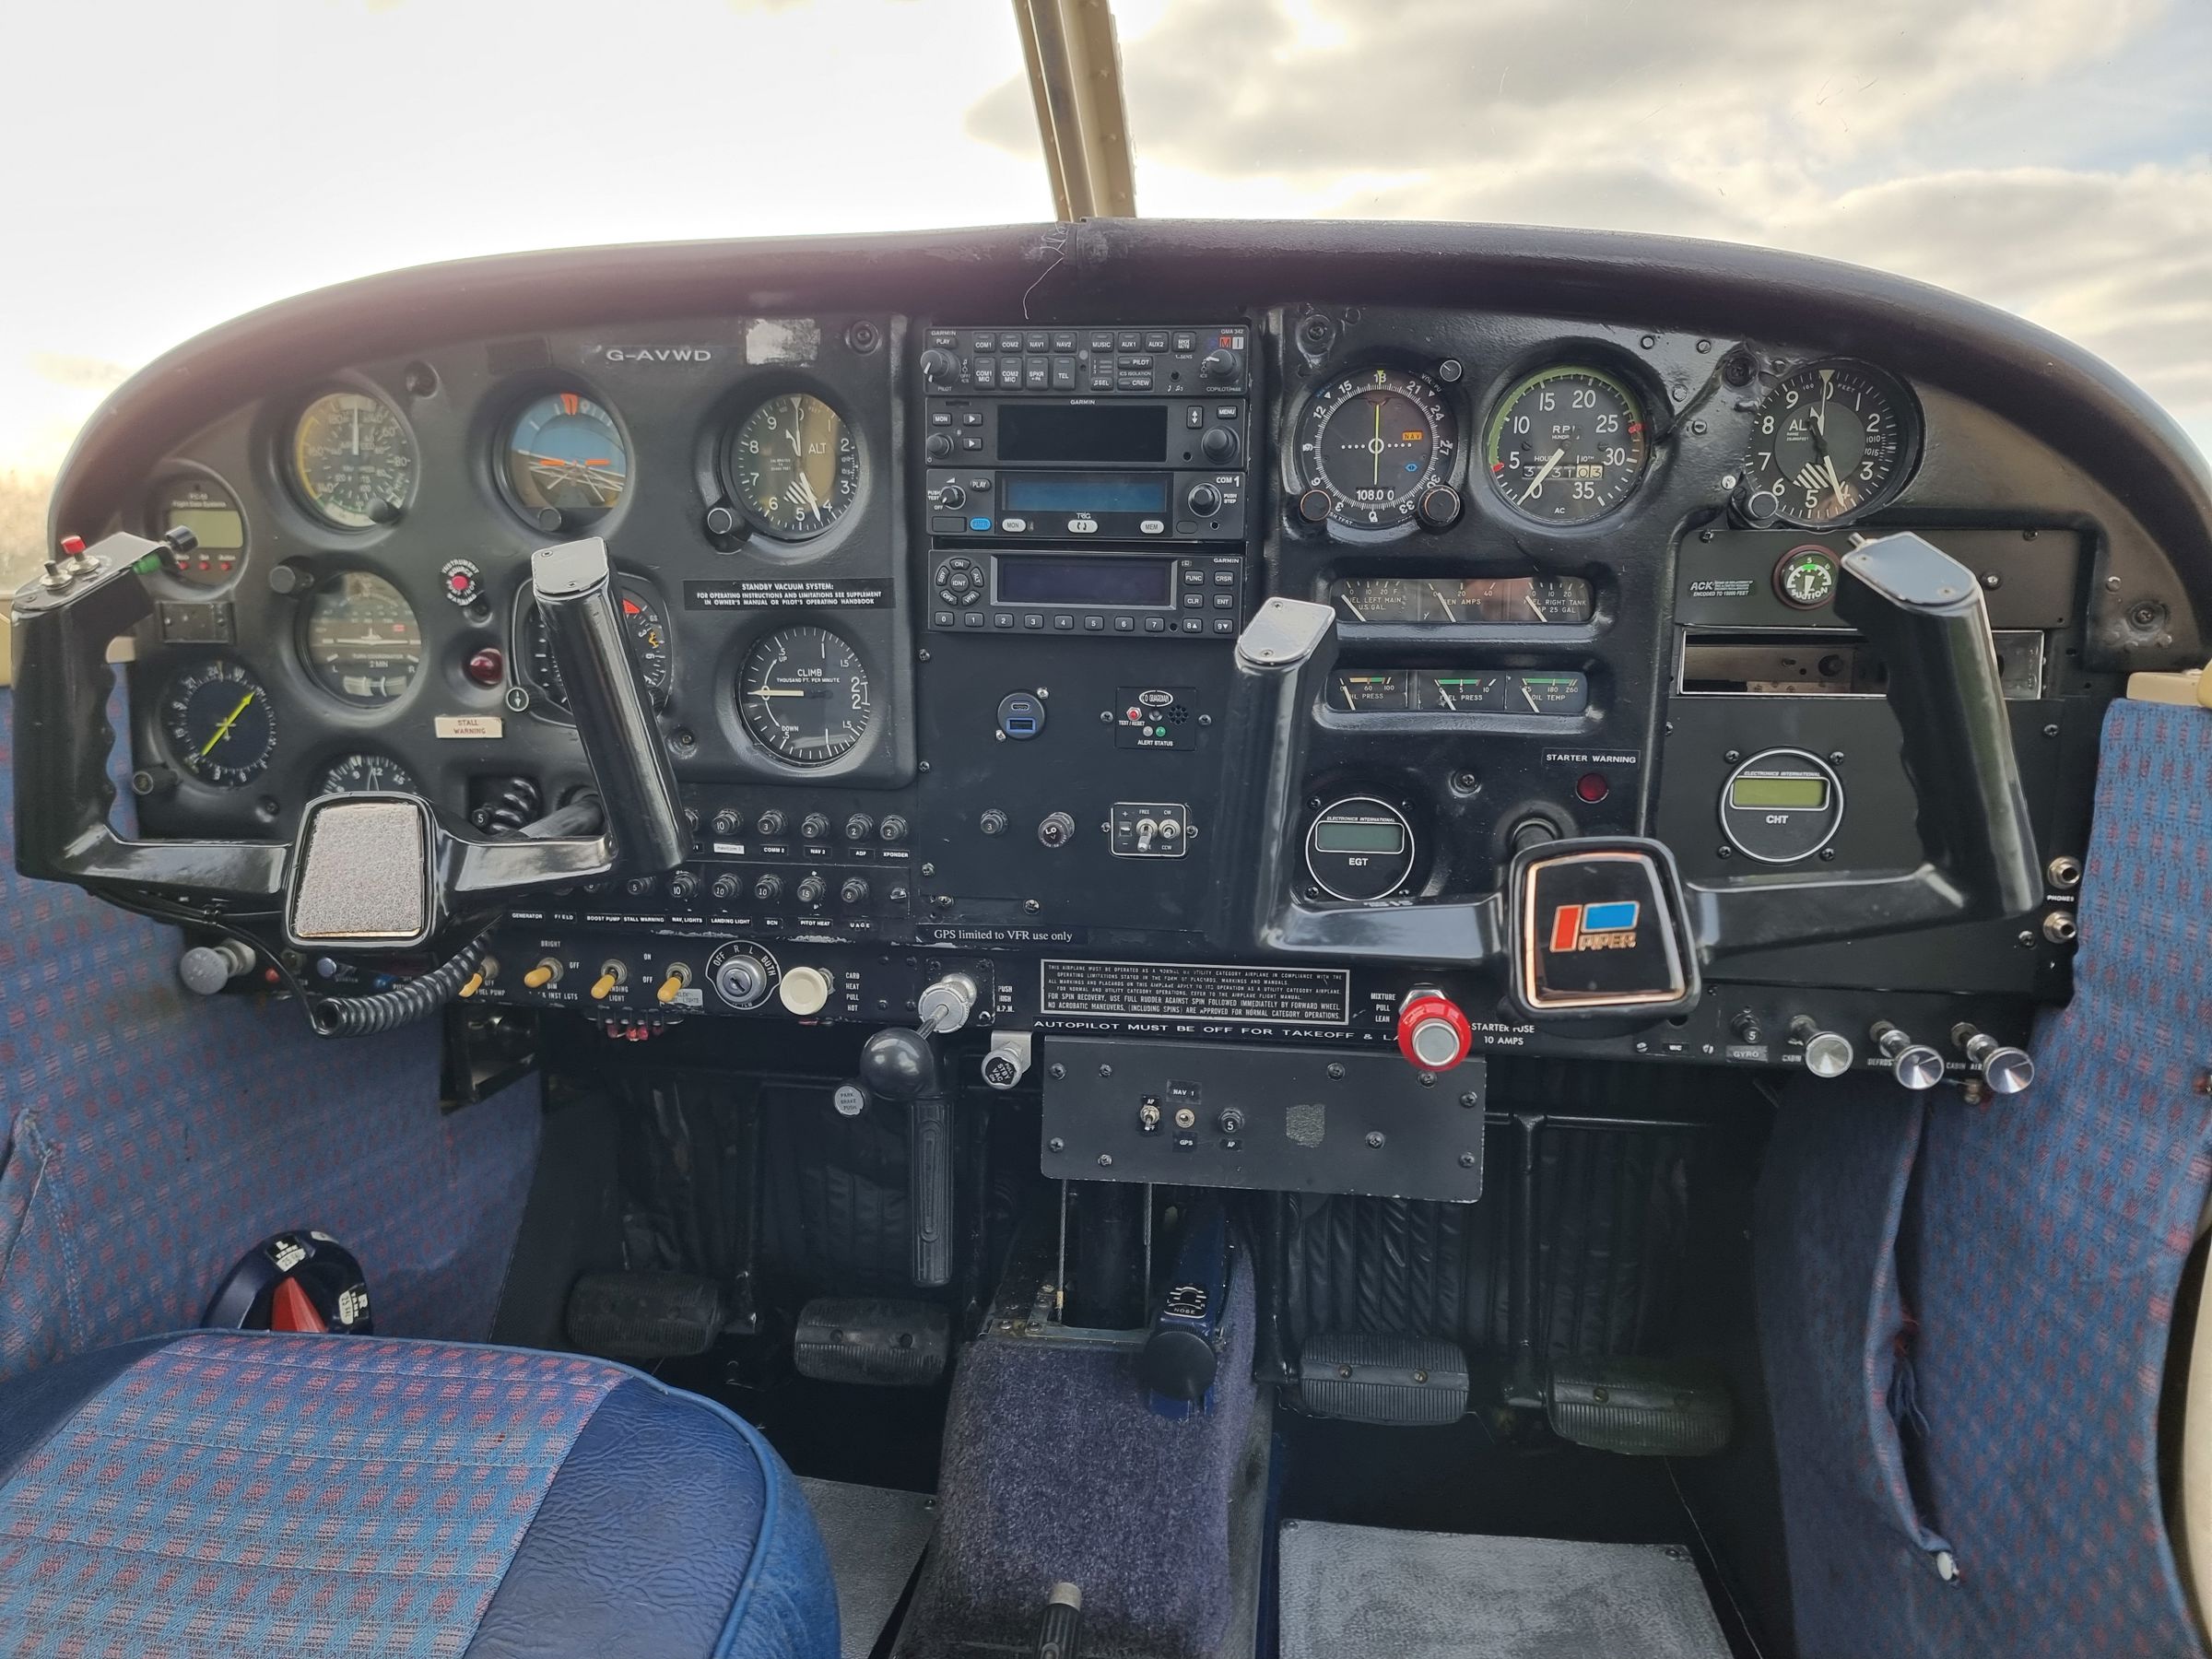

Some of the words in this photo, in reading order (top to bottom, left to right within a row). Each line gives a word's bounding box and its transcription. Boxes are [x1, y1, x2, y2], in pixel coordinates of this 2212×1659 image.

[975, 341, 993, 349] COM1
[606, 348, 712, 361] G-AVWD
[1338, 380, 1353, 394] 15
[1406, 381, 1422, 394] 21
[1539, 392, 1556, 411] 15
[1571, 389, 1596, 408] 20
[1312, 406, 1326, 418] 12
[1430, 405, 1445, 421] 24
[1513, 415, 1530, 434] 10
[1595, 414, 1618, 433] 25
[808, 442, 827, 454] ALT
[1509, 451, 1521, 470] 5
[1603, 447, 1625, 466] 30
[972, 480, 987, 489] PLAY
[1216, 476, 1232, 484] COM
[1233, 476, 1241, 488] 1
[1572, 481, 1594, 500] 35
[1185, 574, 1203, 582] FUNC
[742, 582, 772, 591] STANDBY
[774, 582, 805, 591] VACUUM
[806, 582, 834, 591] SYSTEM:
[1689, 581, 1713, 590] ACK
[797, 668, 823, 677] CLIMB
[1546, 753, 1588, 762] STARTER
[1592, 754, 1636, 765] WARNING
[1765, 815, 1789, 824] CHT
[1348, 857, 1369, 866] EGT
[934, 929, 956, 940] GPS
[958, 929, 993, 941] limited
[994, 931, 1005, 941] to
[1006, 930, 1030, 941] VFR
[1031, 933, 1050, 941] use
[1051, 931, 1074, 944] only
[712, 951, 726, 967] OFF
[760, 955, 777, 977] BOTH
[642, 975, 653, 983] OFF
[845, 971, 860, 980] CARB
[998, 994, 1012, 1003] HIGH
[1047, 992, 1059, 1000] FOR
[1077, 994, 1107, 1002] RECOVERY,
[1124, 994, 1137, 1003] FULL
[1140, 995, 1162, 1004] RUDDER
[1165, 996, 1189, 1005] AGAINST
[1191, 997, 1206, 1006] SPIN
[1208, 998, 1237, 1006] FOLLOWED
[1240, 999, 1278, 1008] IMMEDIATELY
[1290, 1002, 1318, 1010] FORWARD
[1370, 992, 1396, 1001] MIXTURE
[847, 1004, 858, 1012] HOT
[1058, 1002, 1088, 1010] ACROBATIC
[1128, 1004, 1160, 1013] (INCLUDING
[1163, 1005, 1183, 1014] SPINS)
[1185, 1006, 1196, 1014] ARE
[1231, 1007, 1242, 1016] FOR
[1245, 1008, 1268, 1017] NORMAL
[1271, 1009, 1300, 1018] CATEGORY
[1304, 1011, 1341, 1019] OPERATIONS.
[1376, 1004, 1391, 1012] PULL
[1375, 1014, 1391, 1023] LEAN
[1033, 1020, 1121, 1030] AUTOPILOT
[1127, 1023, 1169, 1032] MUST
[1176, 1025, 1195, 1033] BE
[1203, 1026, 1232, 1034] OFF
[1241, 1027, 1274, 1036] FOR
[1281, 1030, 1355, 1040] TAKEOFF
[1362, 1032, 1373, 1041] &
[1483, 1035, 1494, 1044] 10
[1497, 1036, 1524, 1045] AMPS
[997, 1063, 1011, 1079] STBY
[1173, 1307, 1195, 1315] NOSE
